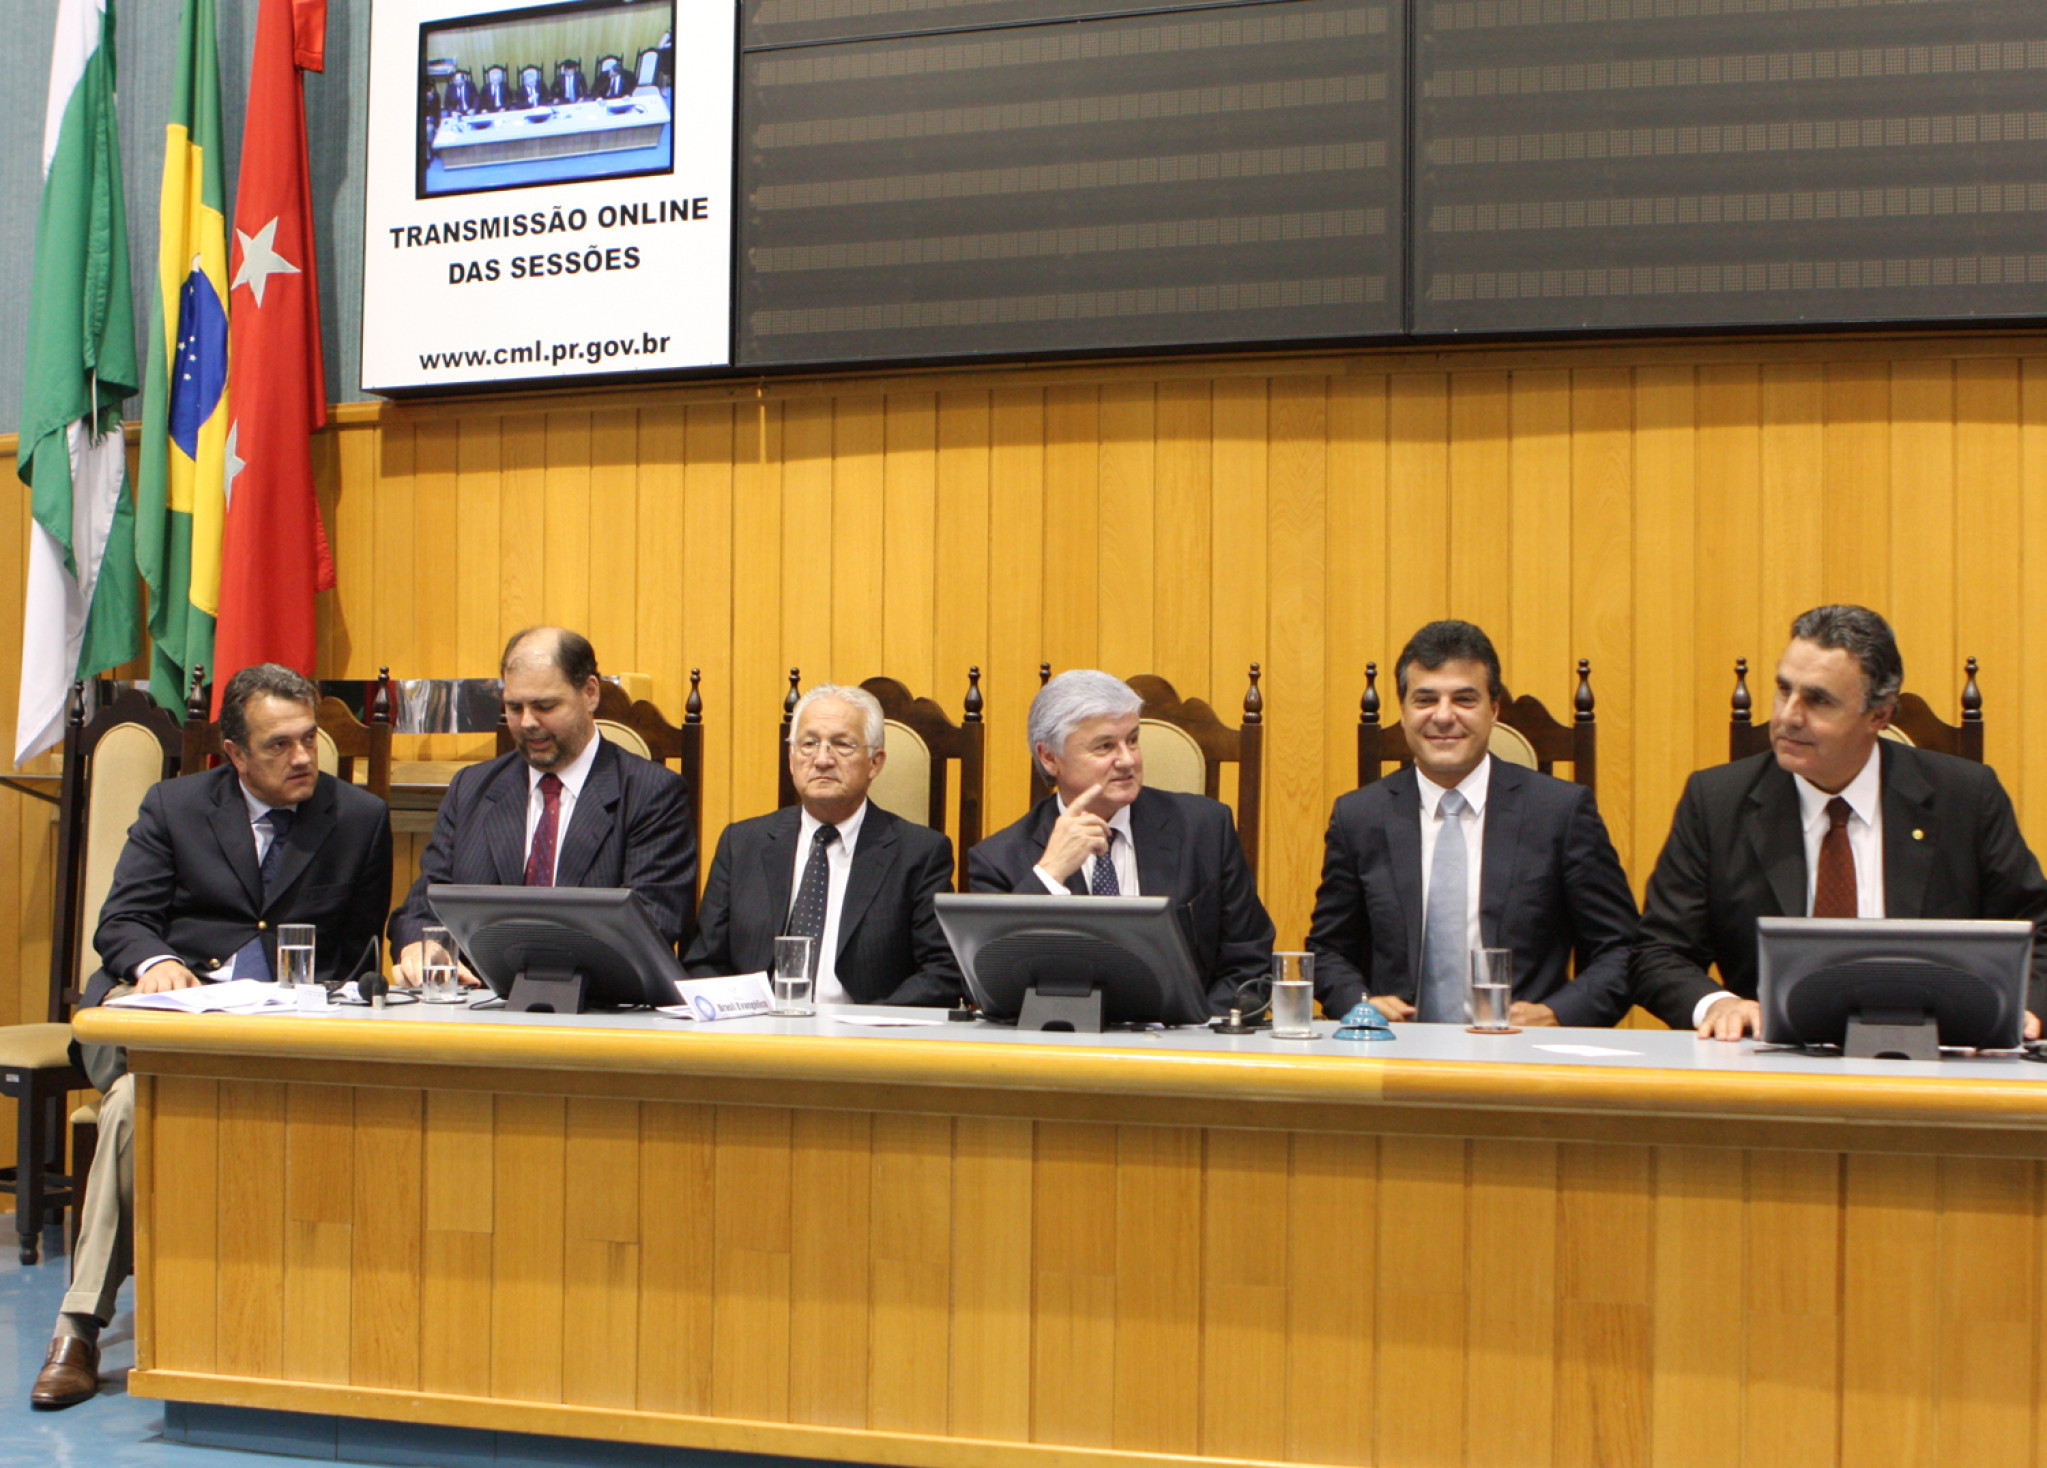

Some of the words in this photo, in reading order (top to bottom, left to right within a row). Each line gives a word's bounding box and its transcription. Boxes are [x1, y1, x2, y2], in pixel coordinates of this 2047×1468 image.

[390, 205, 588, 249] TRANSMISSÃO
[598, 197, 708, 228] ONLINE
[449, 259, 501, 285] DAS
[511, 245, 640, 279] SESSÕES
[420, 332, 671, 370] www.cml.pr.gov.br
